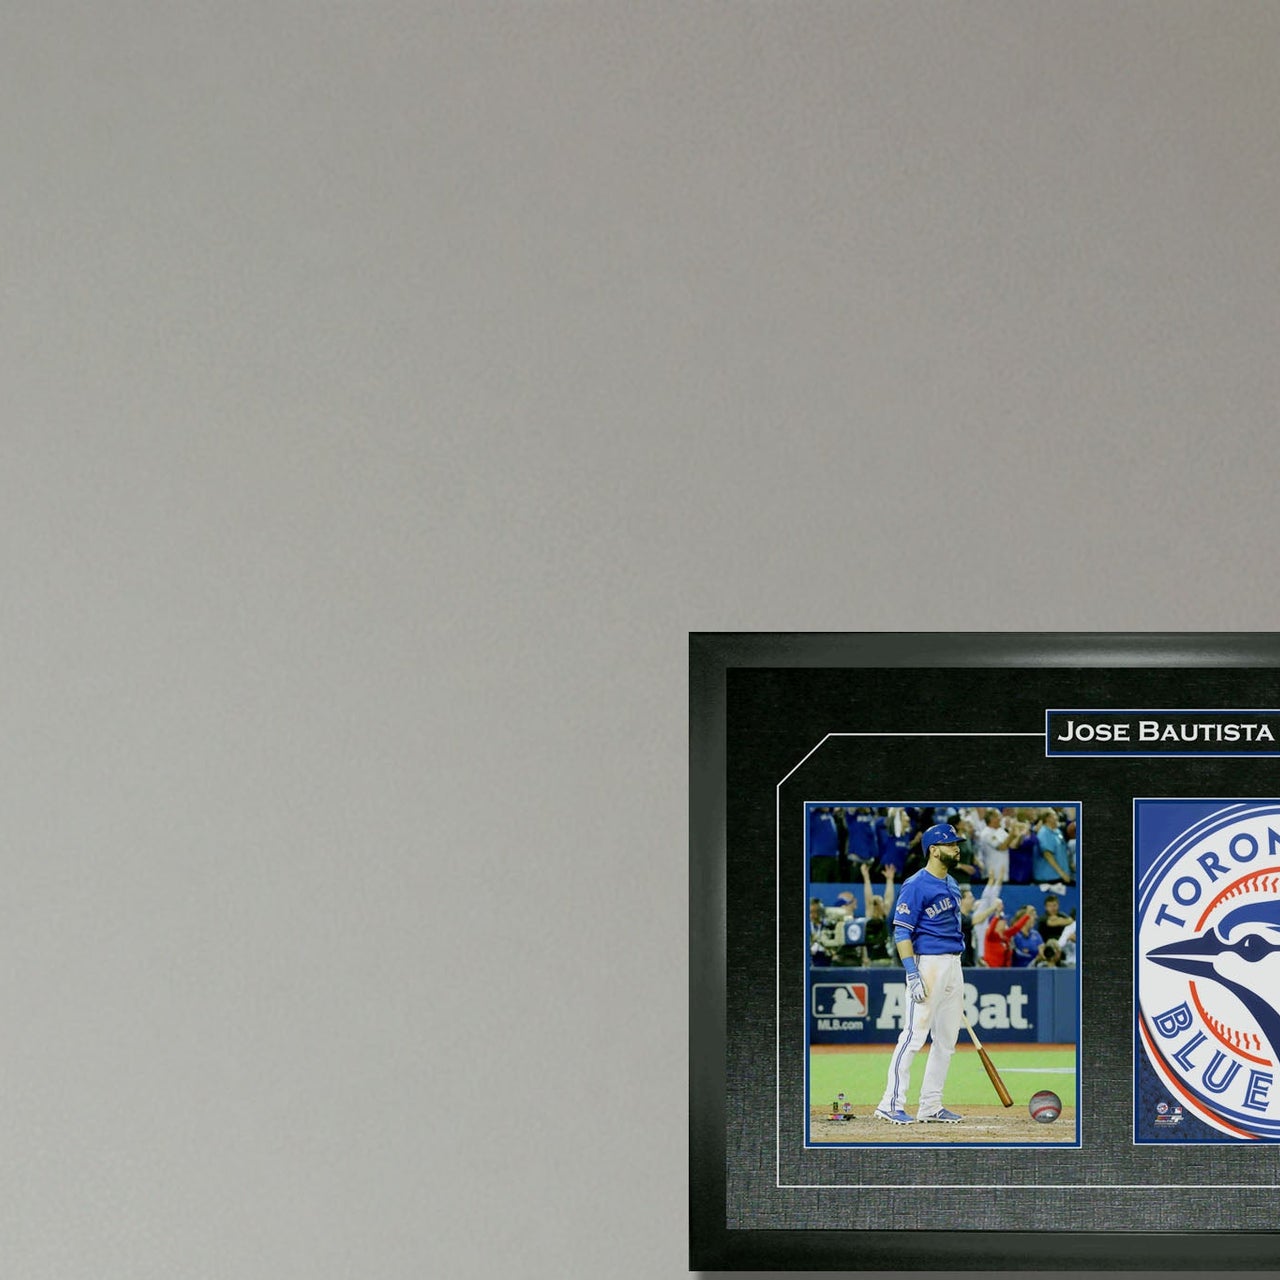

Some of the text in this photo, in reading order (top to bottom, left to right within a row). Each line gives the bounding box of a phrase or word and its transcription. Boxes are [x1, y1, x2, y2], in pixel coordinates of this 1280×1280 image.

[925, 897, 953, 919] BLUE
[817, 1019, 864, 1031] MLB.com
[1151, 1000, 1274, 1113] BLUE
